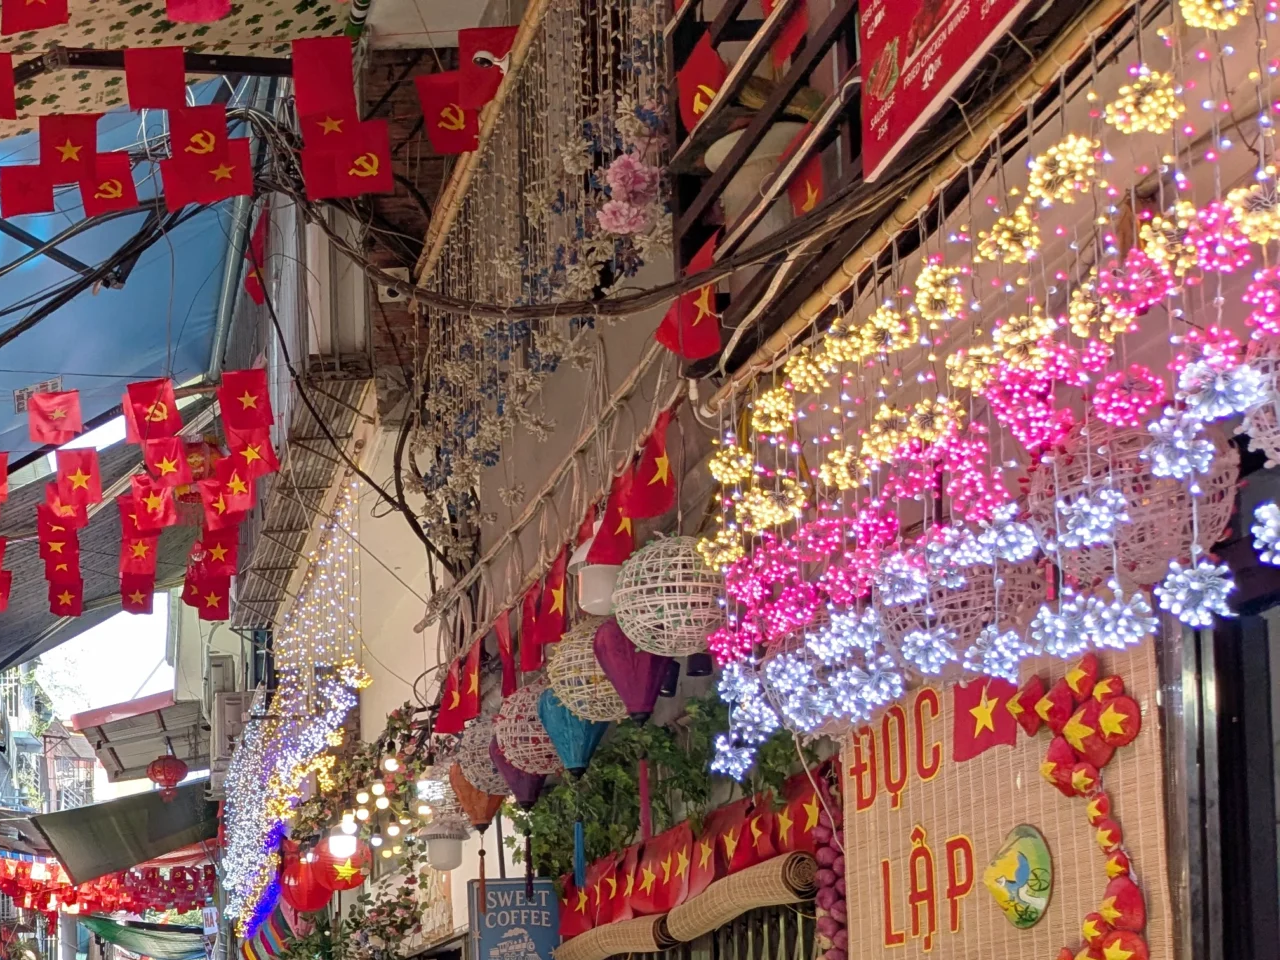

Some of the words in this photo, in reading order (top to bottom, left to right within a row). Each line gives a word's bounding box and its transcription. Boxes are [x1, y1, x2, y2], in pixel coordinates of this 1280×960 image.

[903, 61, 921, 90] FRIED
[920, 30, 947, 67] CHICKEN
[870, 92, 896, 131] SAUSAGE
[849, 687, 942, 813] ĐỘC
[880, 824, 974, 952] LẬP
[485, 910, 551, 929] COFFEE
